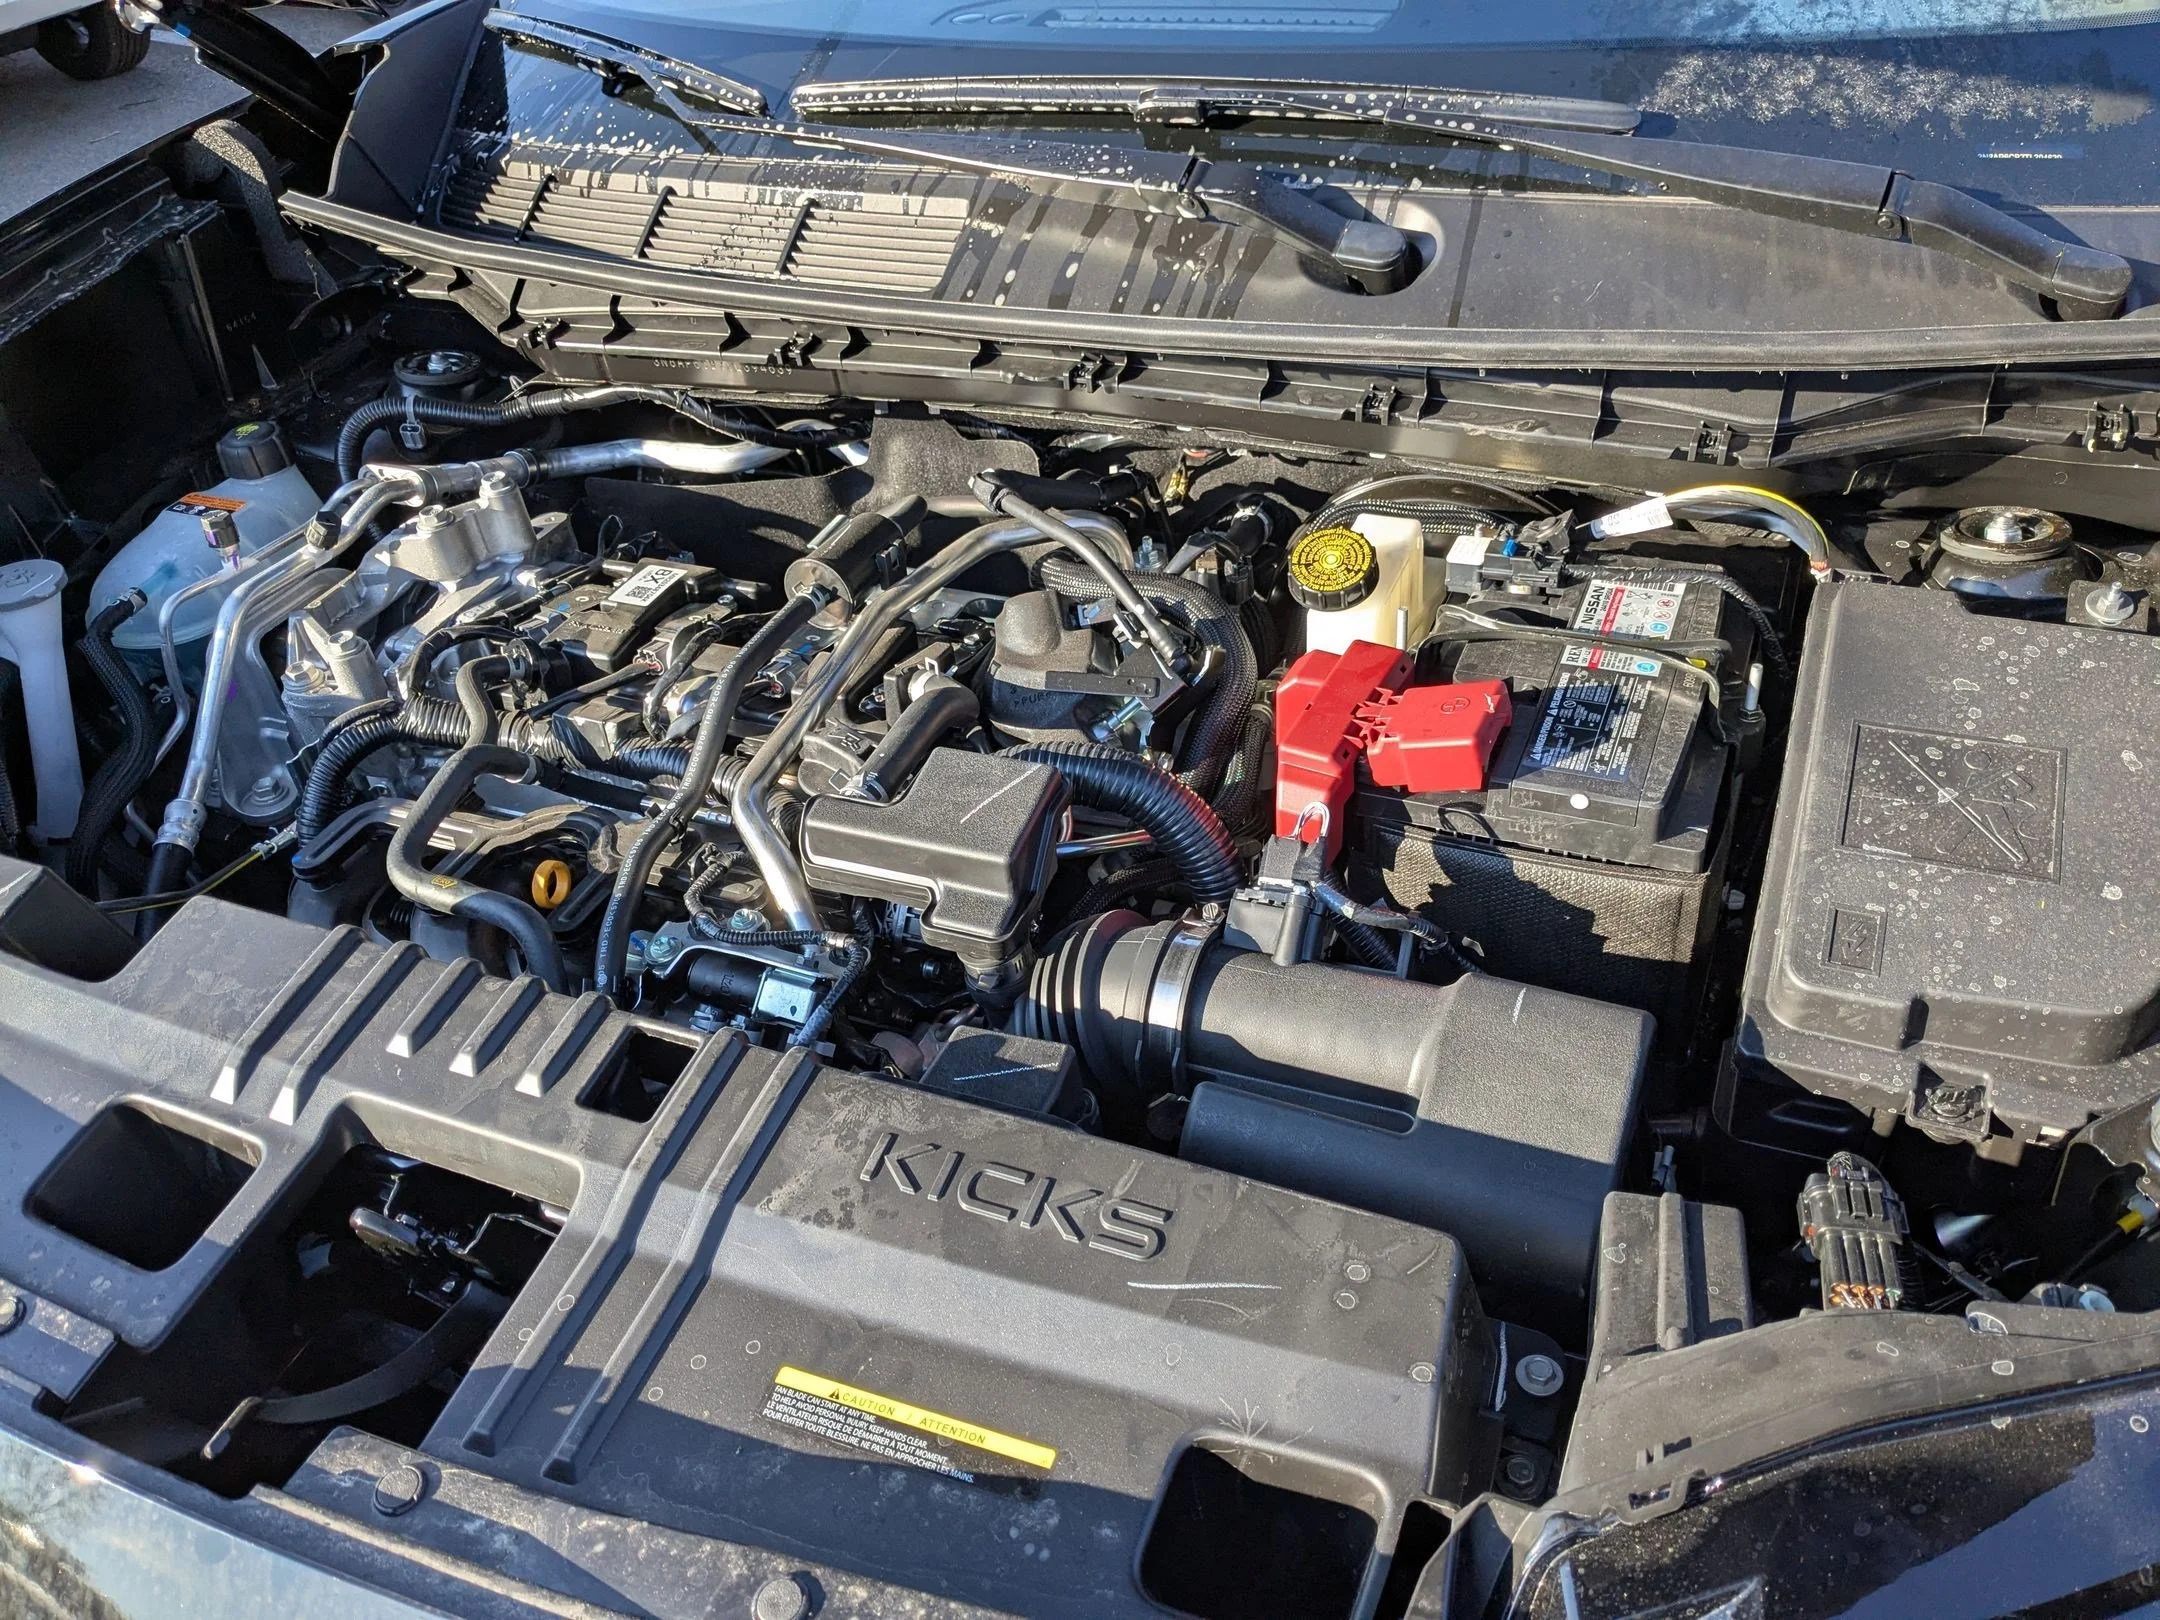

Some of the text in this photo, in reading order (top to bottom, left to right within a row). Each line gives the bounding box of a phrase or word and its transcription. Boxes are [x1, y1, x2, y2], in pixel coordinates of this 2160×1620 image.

[643, 568, 673, 584] BX
[1581, 586, 1606, 625] NISSAN
[860, 1133, 1173, 1262] KICKS
[772, 1392, 782, 1402] TO
[780, 1395, 797, 1406] HELP
[795, 1400, 816, 1413] AVOID
[814, 1405, 846, 1422] PERSONAL
[868, 1422, 885, 1434] KEEP
[884, 1429, 907, 1443] HANDS
[775, 1385, 787, 1394] FAN
[787, 1388, 807, 1400] BLADE
[807, 1393, 822, 1404] CAN
[820, 1398, 840, 1410] START
[838, 1404, 848, 1413] AT
[847, 1406, 861, 1417] ANY
[842, 1392, 896, 1416] CAUTION
[919, 1417, 986, 1444] ATTENTION
[762, 1408, 782, 1420] POUR
[782, 1411, 804, 1428] ÉVITER
[804, 1421, 827, 1435] TOUTE
[860, 1440, 871, 1450] NE
[871, 1443, 884, 1454] PAS
[884, 1448, 895, 1457] EN
[894, 1451, 937, 1471] APPROCHER
[936, 1463, 950, 1475] LES
[766, 1401, 776, 1410] LE
[775, 1403, 818, 1422] VENTILATEUR
[818, 1417, 842, 1431] RISQUE
[842, 1425, 853, 1434] DE
[852, 1426, 890, 1447] DÉMARRER
[897, 1441, 915, 1454] TOUT
